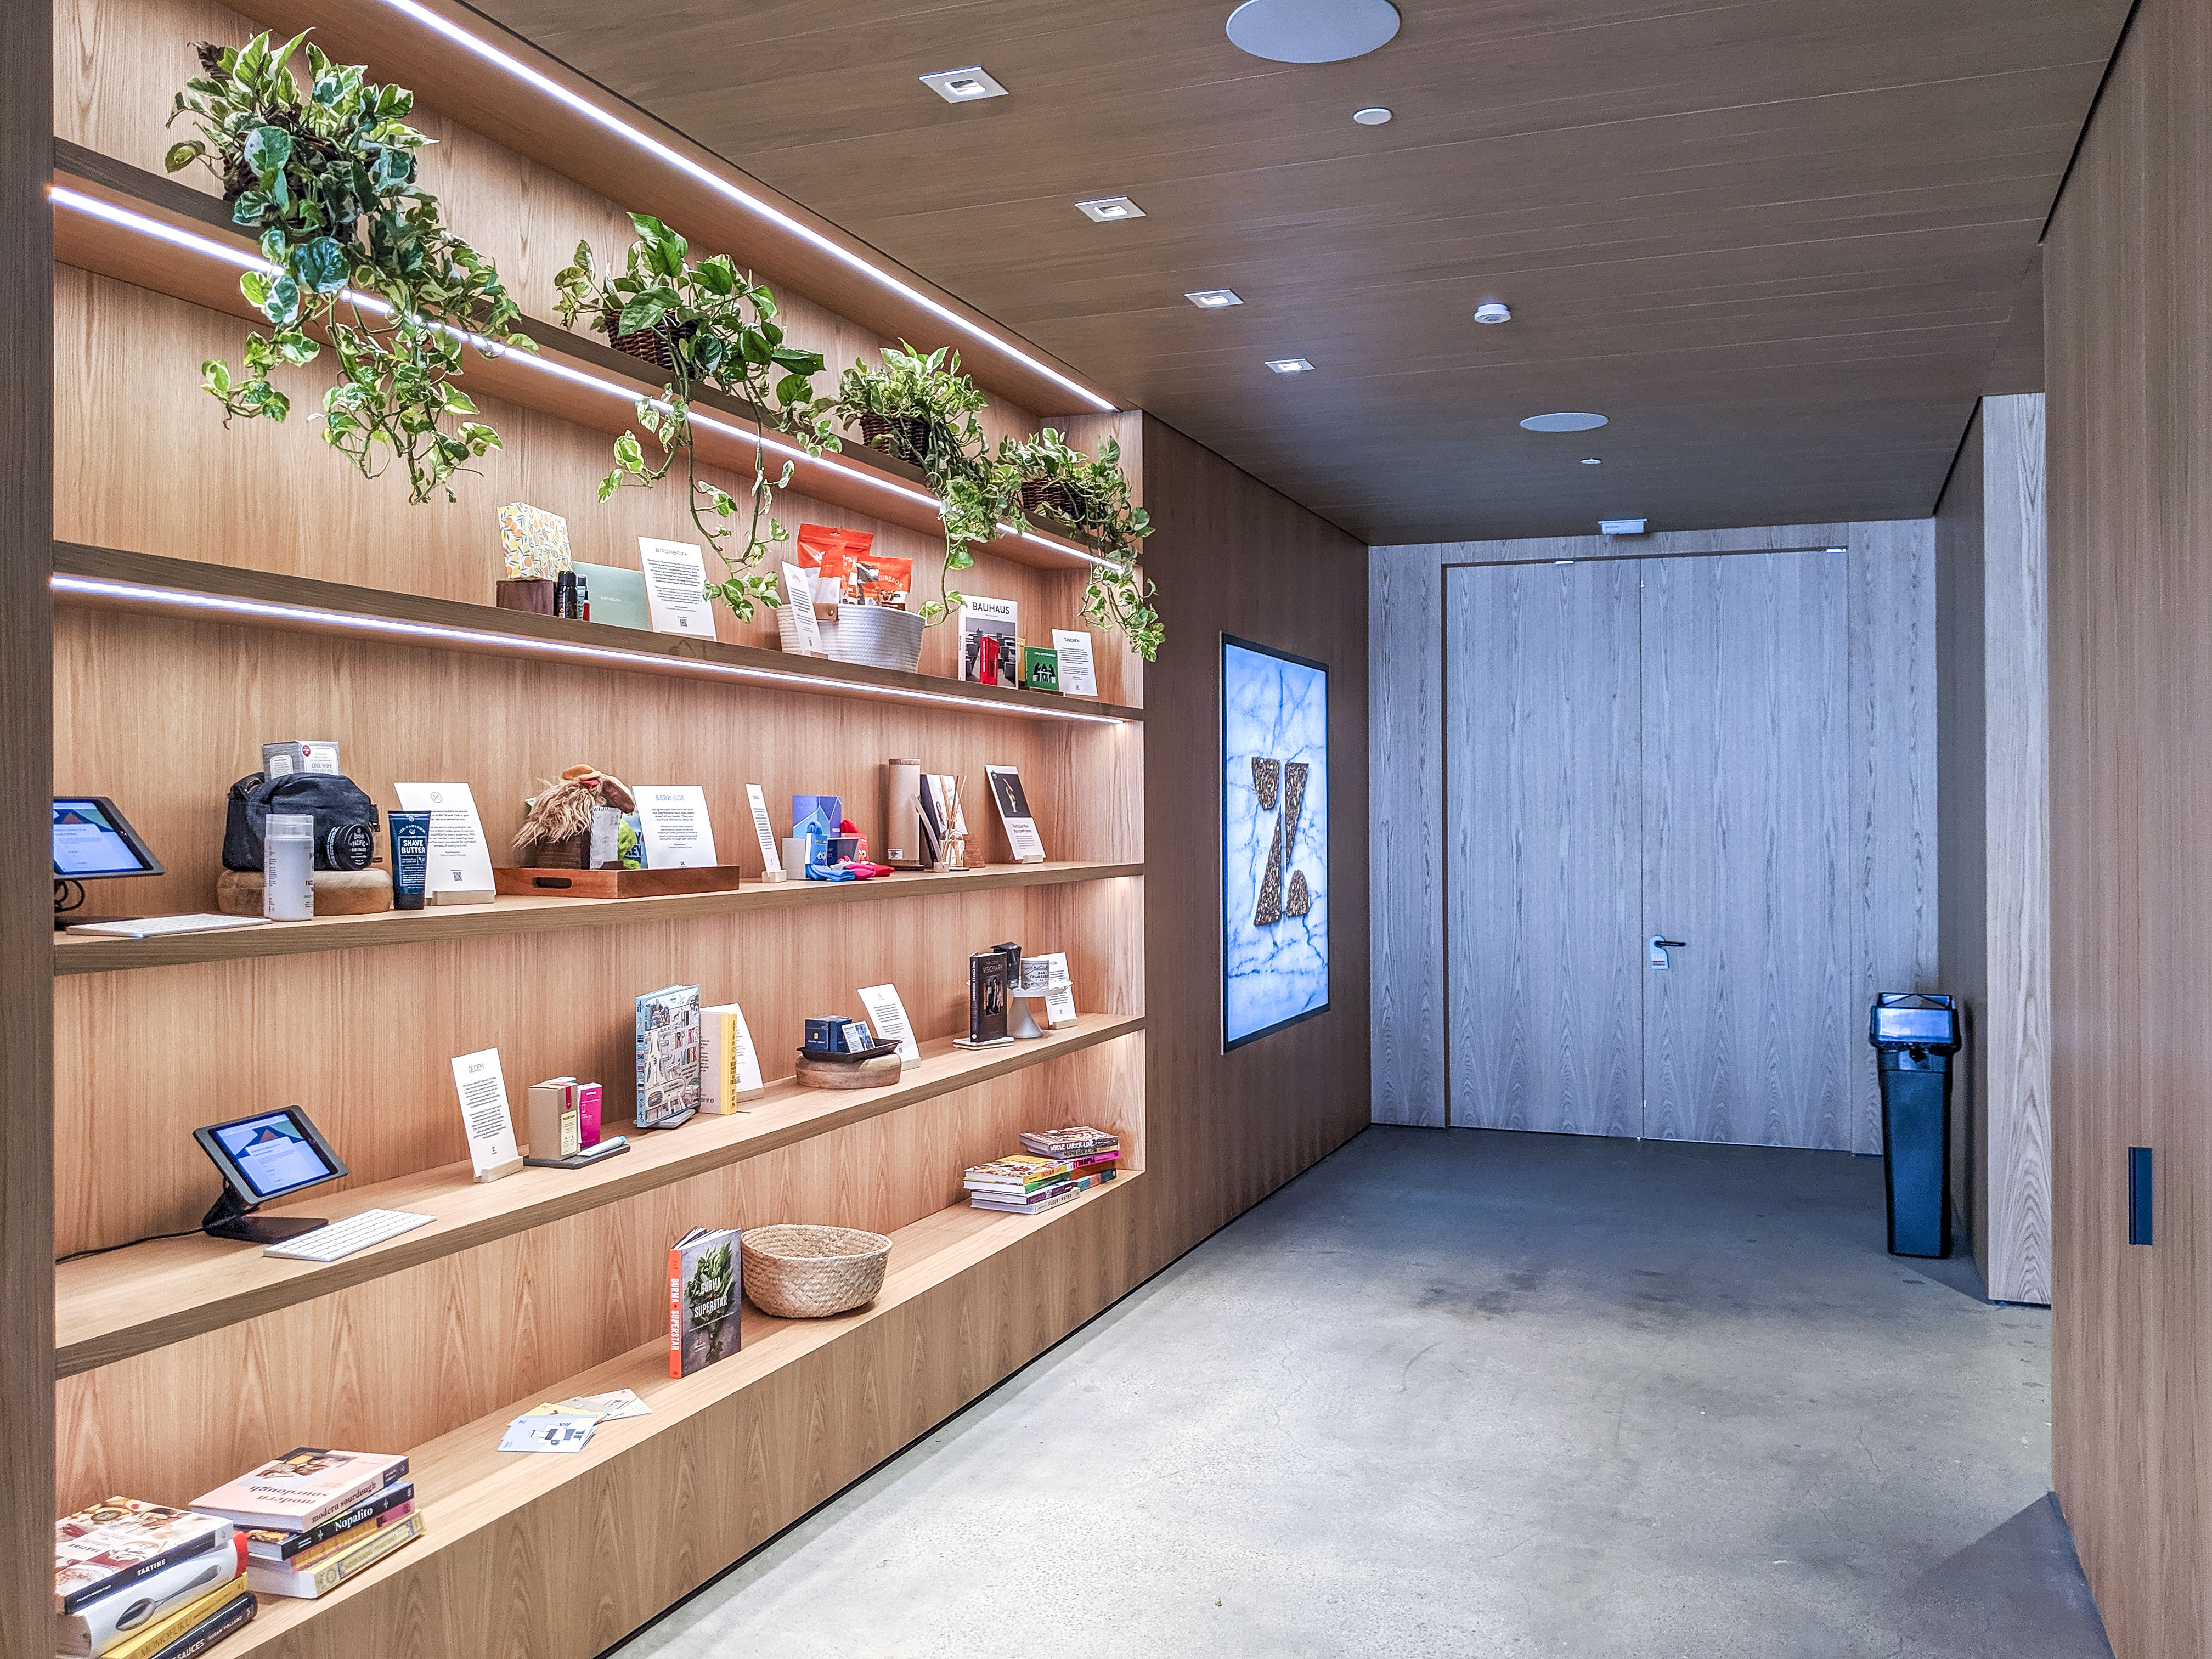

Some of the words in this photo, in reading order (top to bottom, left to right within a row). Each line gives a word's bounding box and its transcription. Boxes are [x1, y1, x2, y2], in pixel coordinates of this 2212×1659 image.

[973, 602, 1009, 614] BAUHAUS
[671, 1278, 680, 1304] BURMA
[701, 1276, 721, 1294] BURMA
[695, 1295, 727, 1318] SUPERSTAR
[671, 1310, 680, 1351] SUPERSTAR
[250, 1486, 329, 1497] sourdough
[257, 1495, 317, 1504] modern
[312, 1505, 340, 1523] modern
[340, 1481, 376, 1506] sourdough
[334, 1507, 373, 1532] Nopalito
[137, 1559, 166, 1576] TARTINE
[177, 1639, 205, 1659] SAUCES
